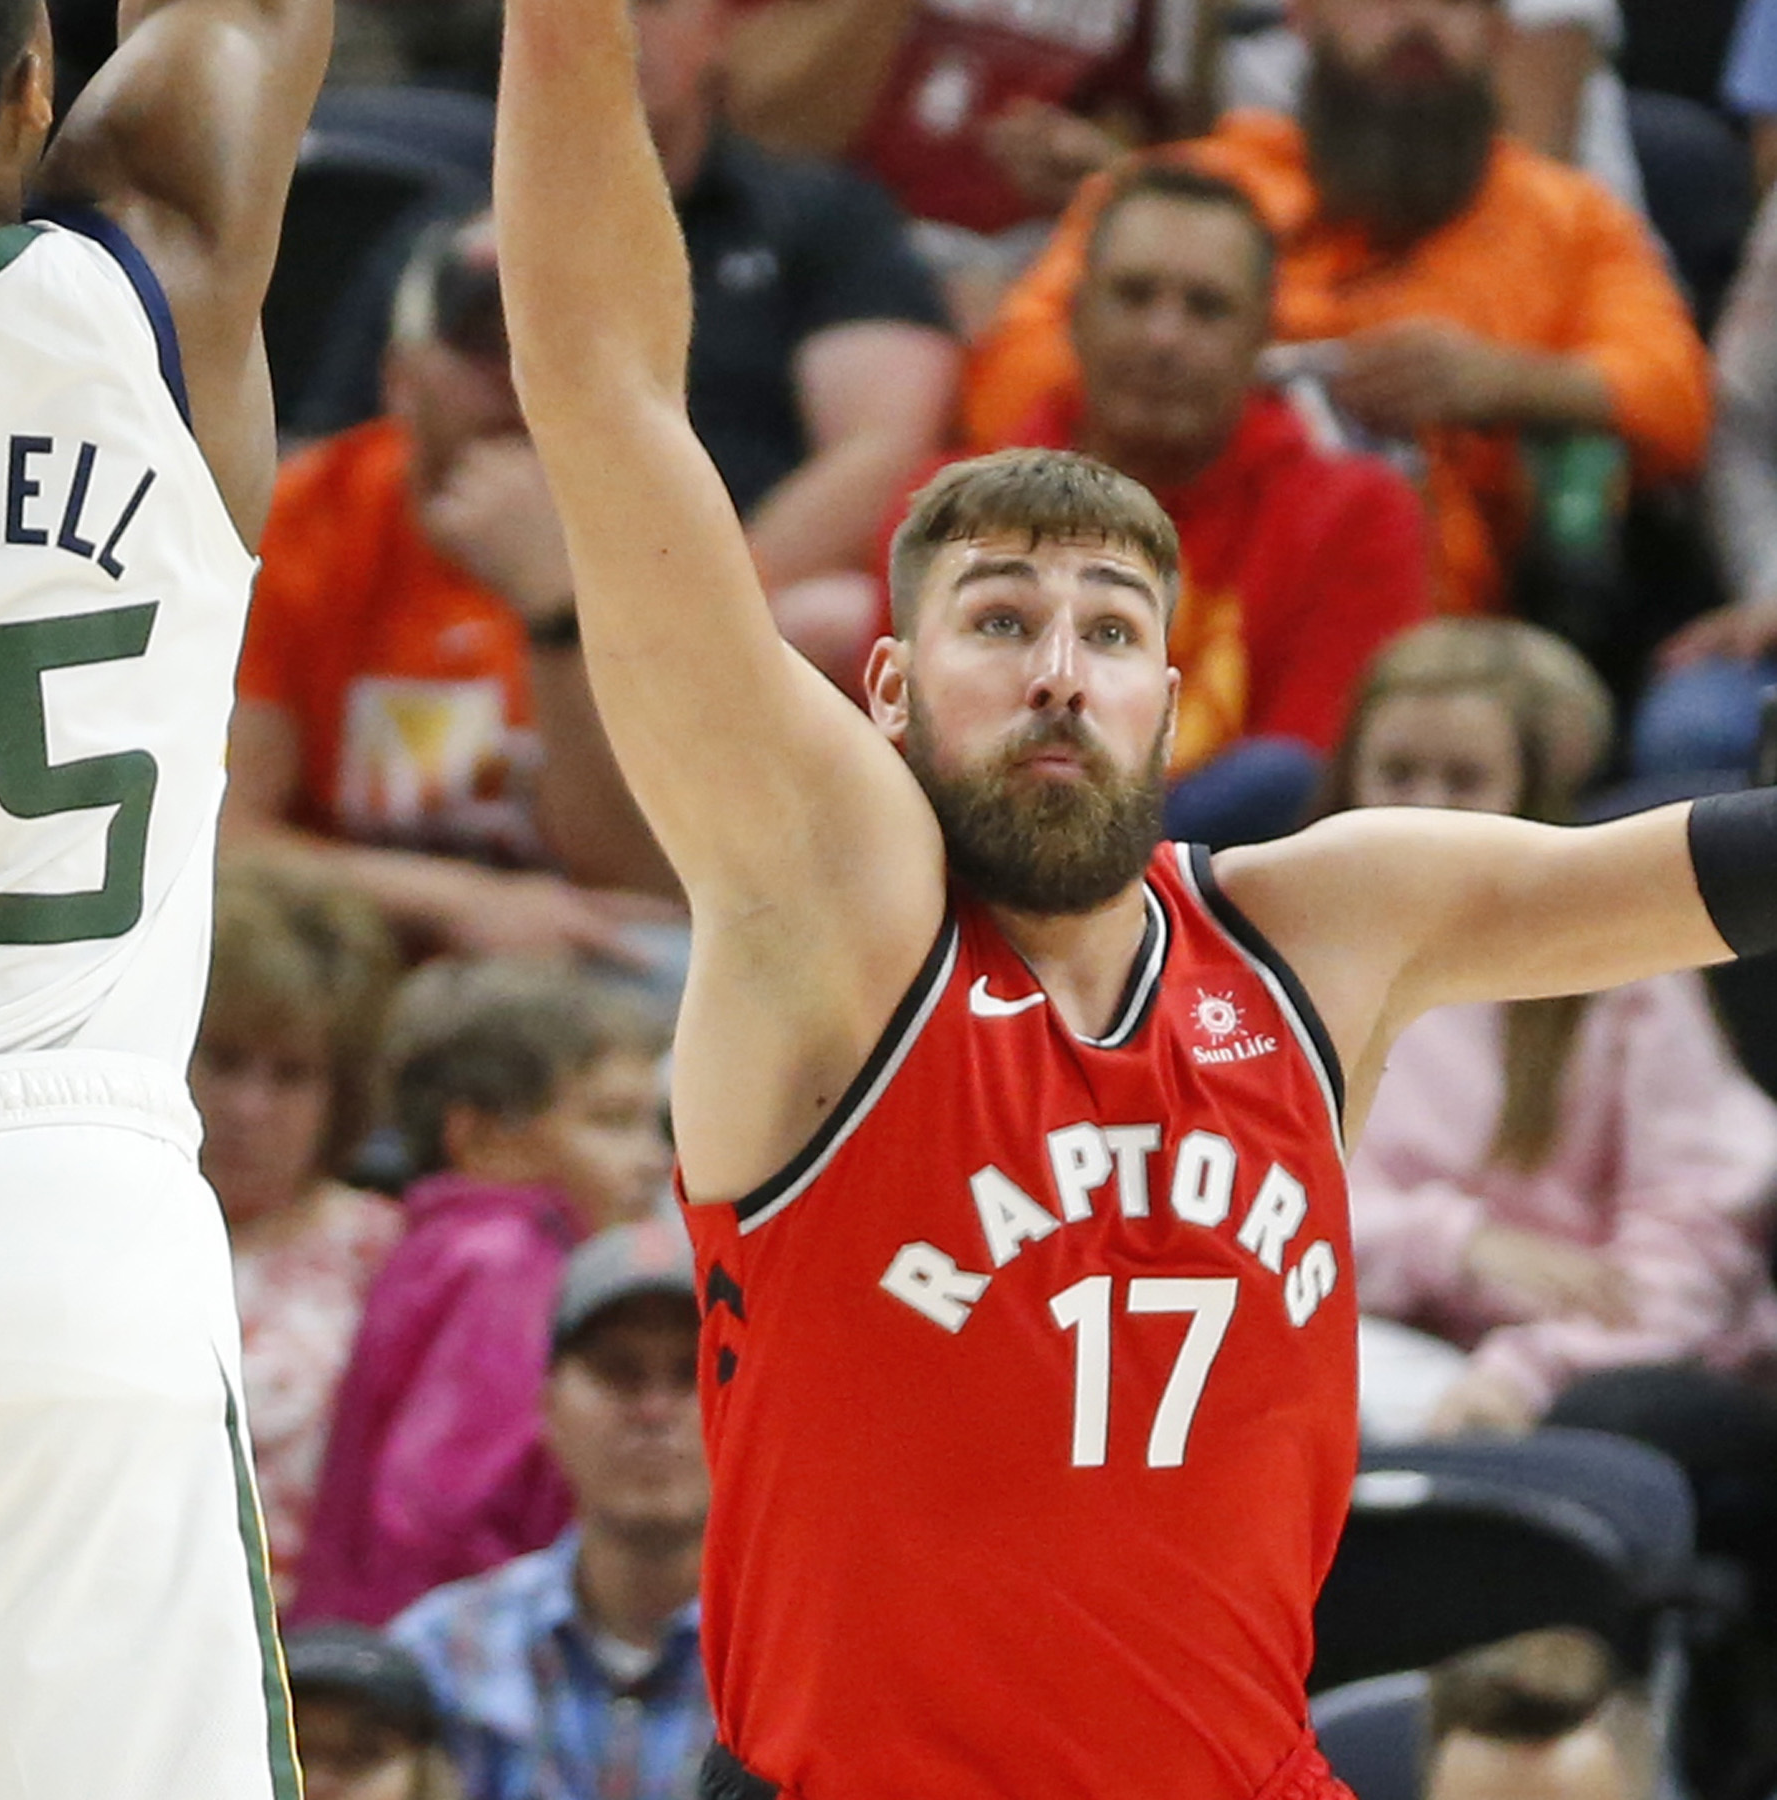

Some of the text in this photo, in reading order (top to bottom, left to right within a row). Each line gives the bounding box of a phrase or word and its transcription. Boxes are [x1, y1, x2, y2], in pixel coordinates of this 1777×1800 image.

[1192, 1033, 1278, 1064] Sun Life
[877, 1120, 1339, 1335] RAPTORS
[1048, 1273, 1240, 1469] 17
